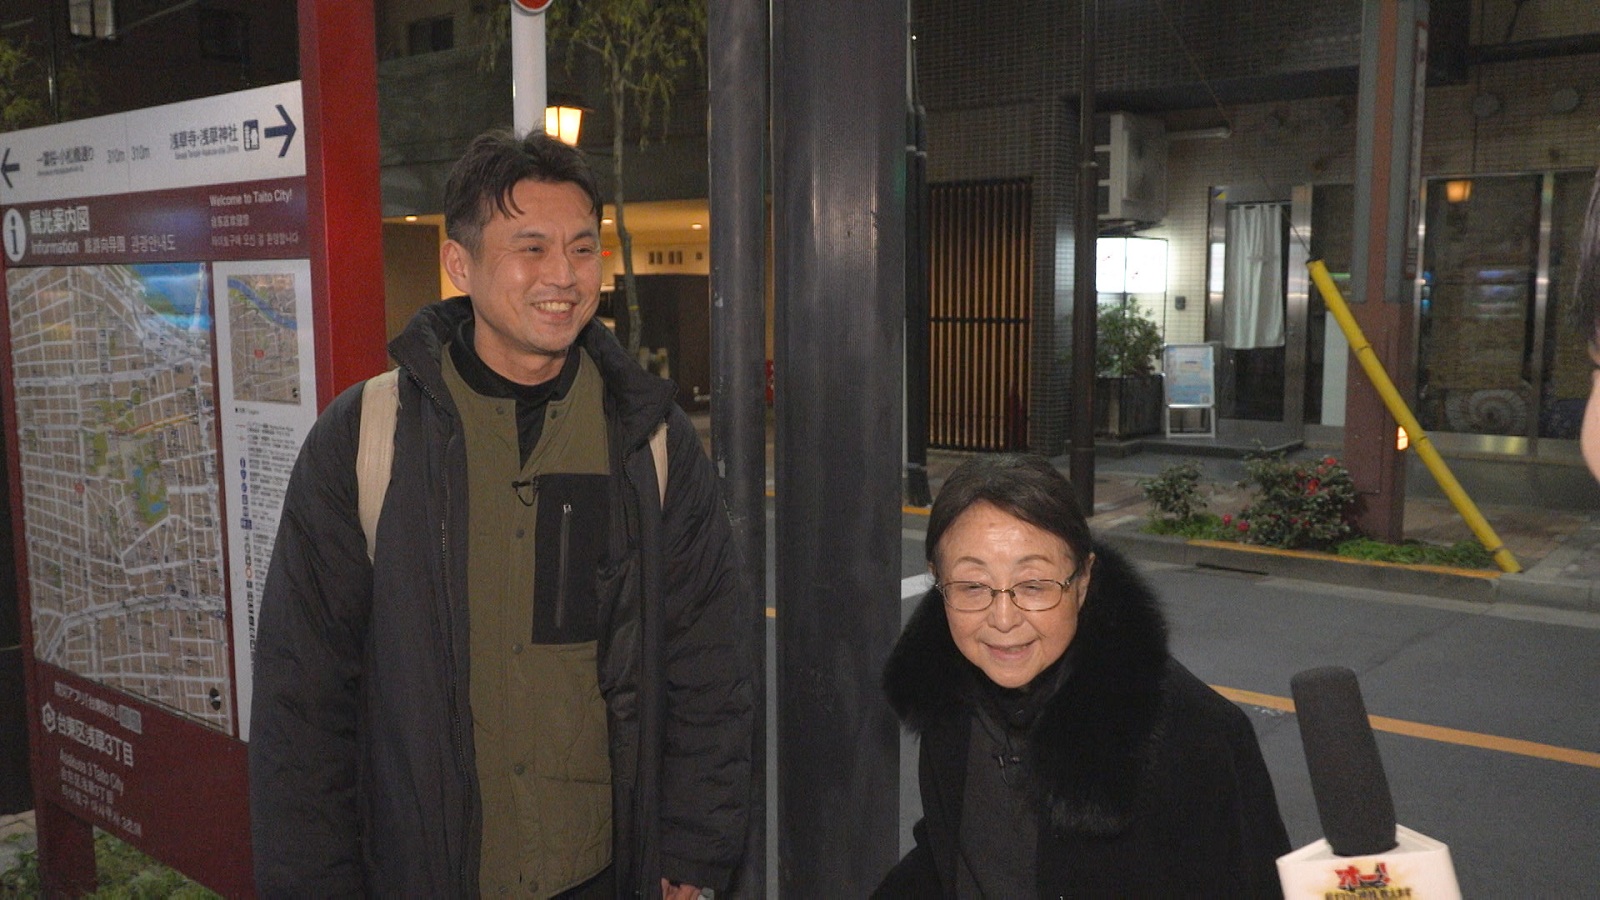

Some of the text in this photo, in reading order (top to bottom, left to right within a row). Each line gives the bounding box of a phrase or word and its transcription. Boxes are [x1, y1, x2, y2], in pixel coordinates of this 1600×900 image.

[209, 194, 242, 207] Welcome
[243, 193, 252, 205] to
[253, 191, 273, 204] Taito
[30, 205, 90, 234] 観光案内図
[32, 240, 79, 254] Information
